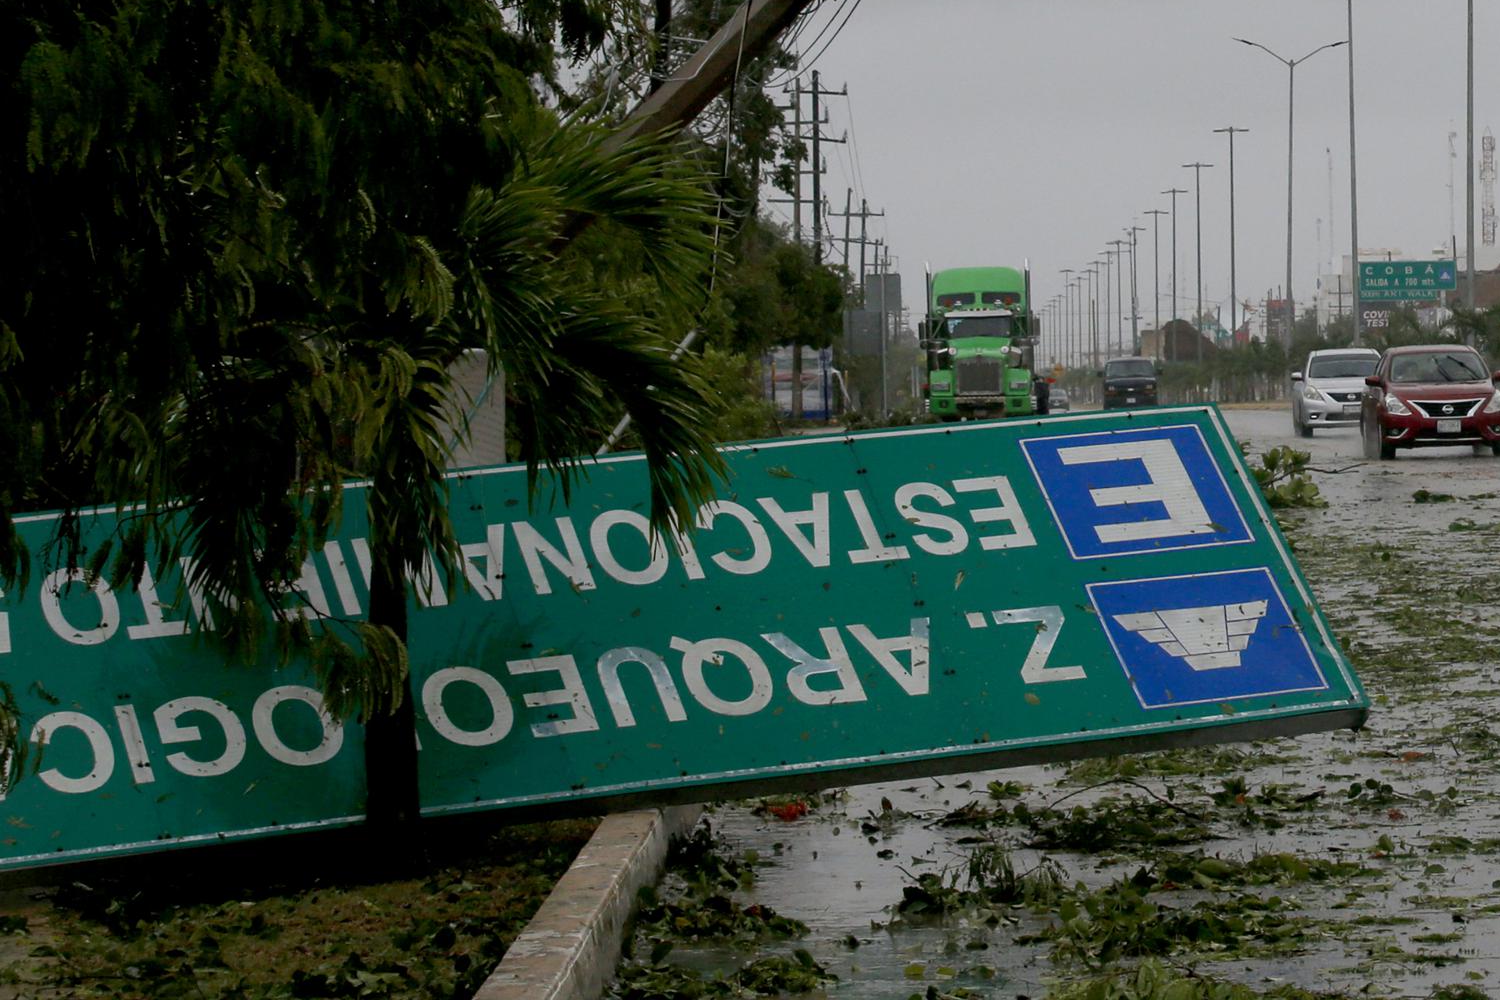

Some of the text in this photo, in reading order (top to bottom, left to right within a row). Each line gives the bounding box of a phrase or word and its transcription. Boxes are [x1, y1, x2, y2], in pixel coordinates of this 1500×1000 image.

[1363, 310, 1391, 319] COVI
[1366, 278, 1388, 287] SALIDA
[1394, 278, 1400, 287] A
[1056, 438, 1216, 543] E
[966, 605, 1087, 684] Z.
[0, 617, 930, 801] ARQUEOOGIC
